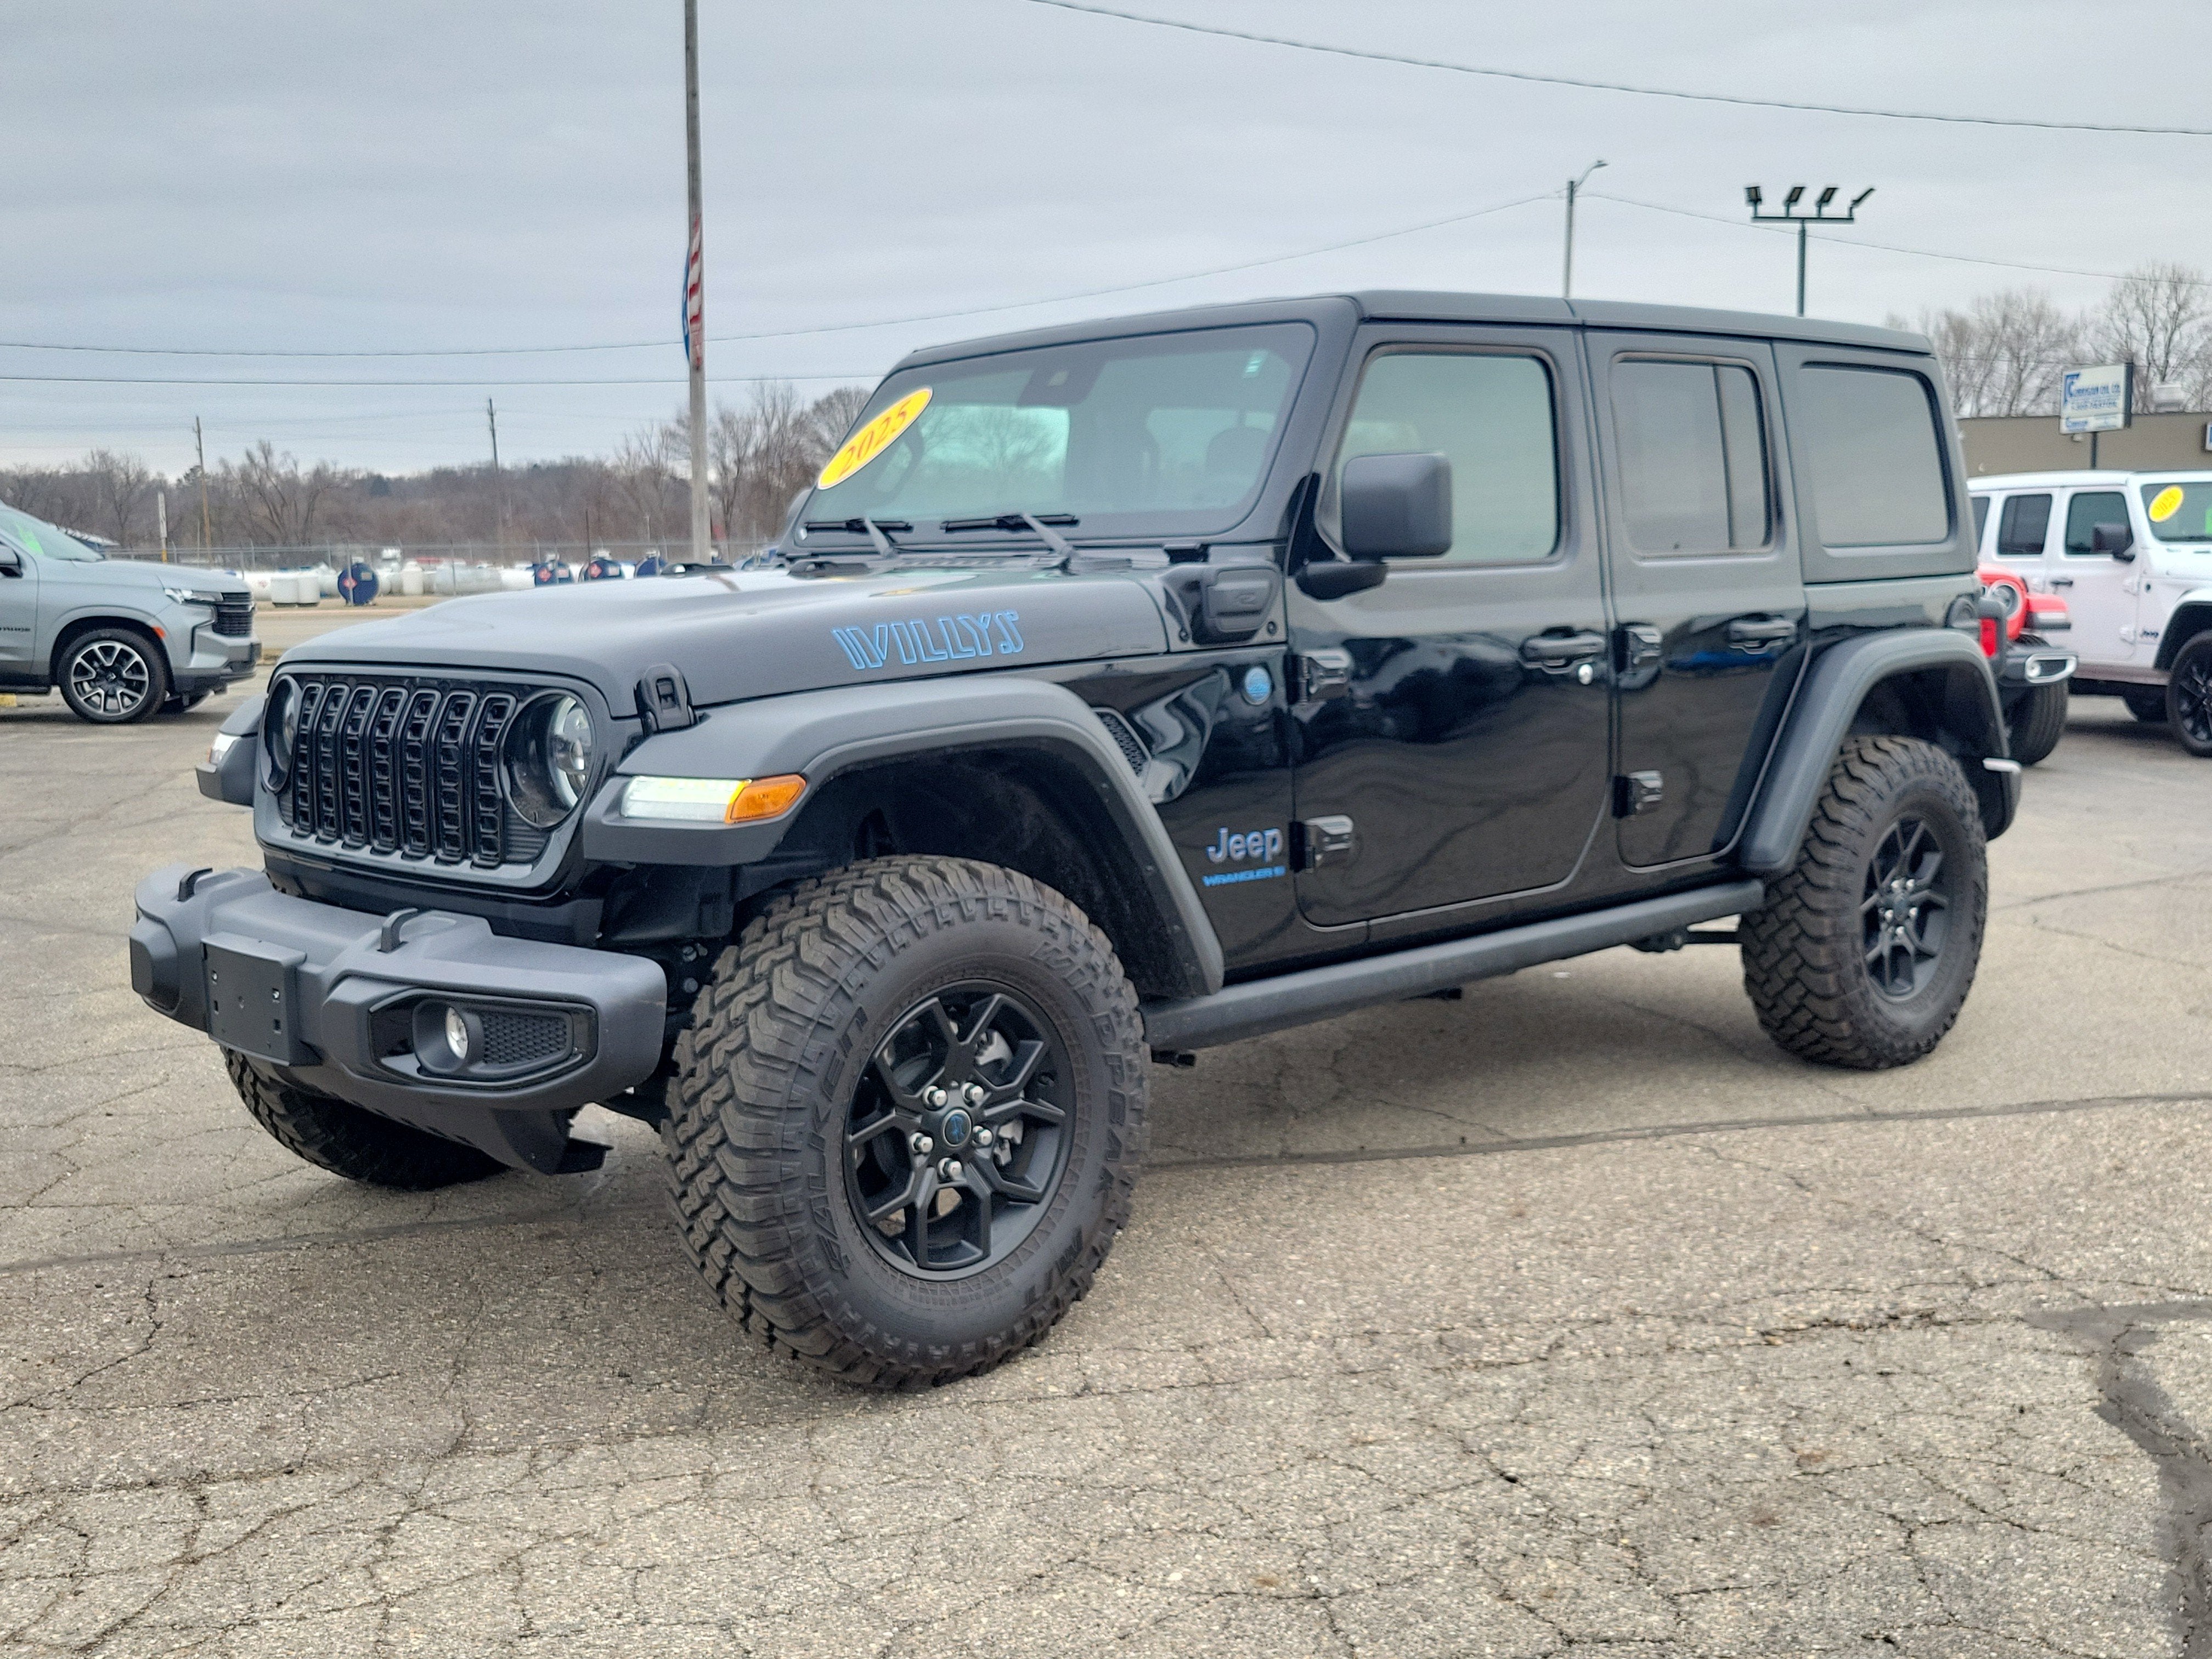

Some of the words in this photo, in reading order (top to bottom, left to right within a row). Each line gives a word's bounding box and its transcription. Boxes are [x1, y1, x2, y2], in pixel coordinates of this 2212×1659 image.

[839, 399, 911, 478] 2025
[831, 610, 1024, 670] WILLYS
[1206, 827, 1284, 864] Jeep
